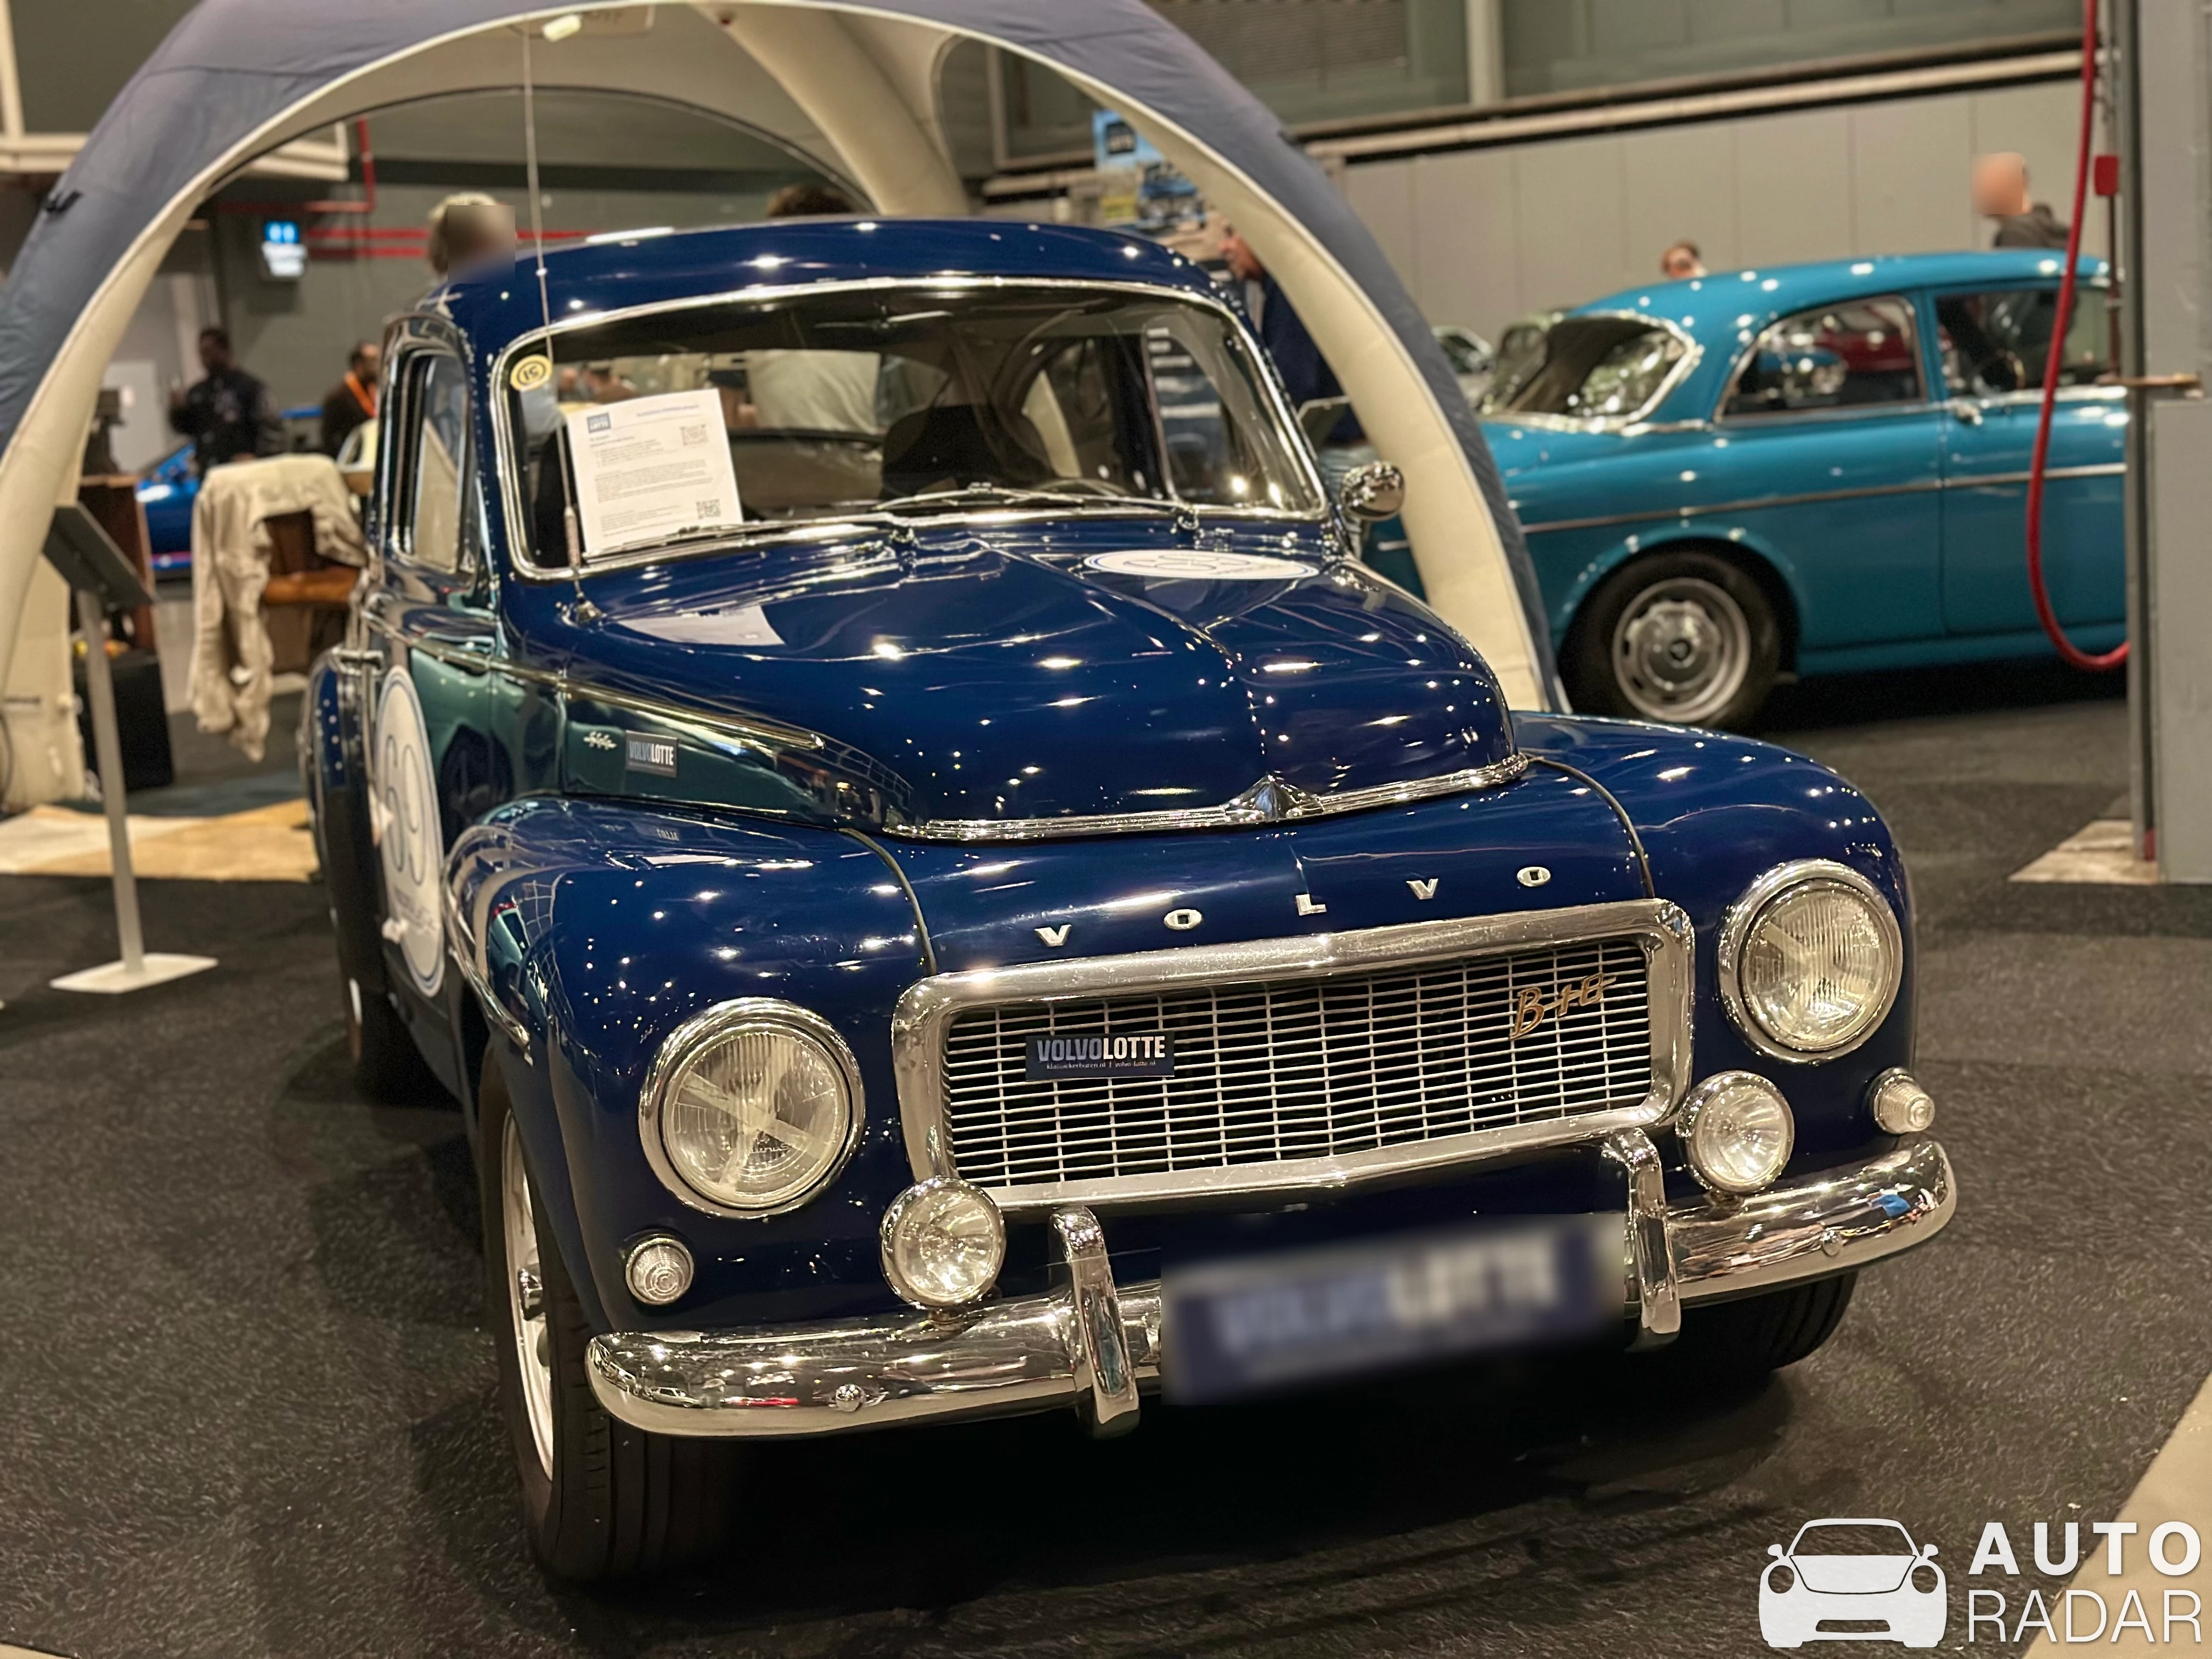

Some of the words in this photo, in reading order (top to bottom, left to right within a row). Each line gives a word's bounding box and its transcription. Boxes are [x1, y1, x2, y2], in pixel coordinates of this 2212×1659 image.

[385, 734, 427, 887] 69
[1034, 866, 1551, 947] VOLVO
[1037, 1036, 1165, 1062] VOLVOLOTTE
